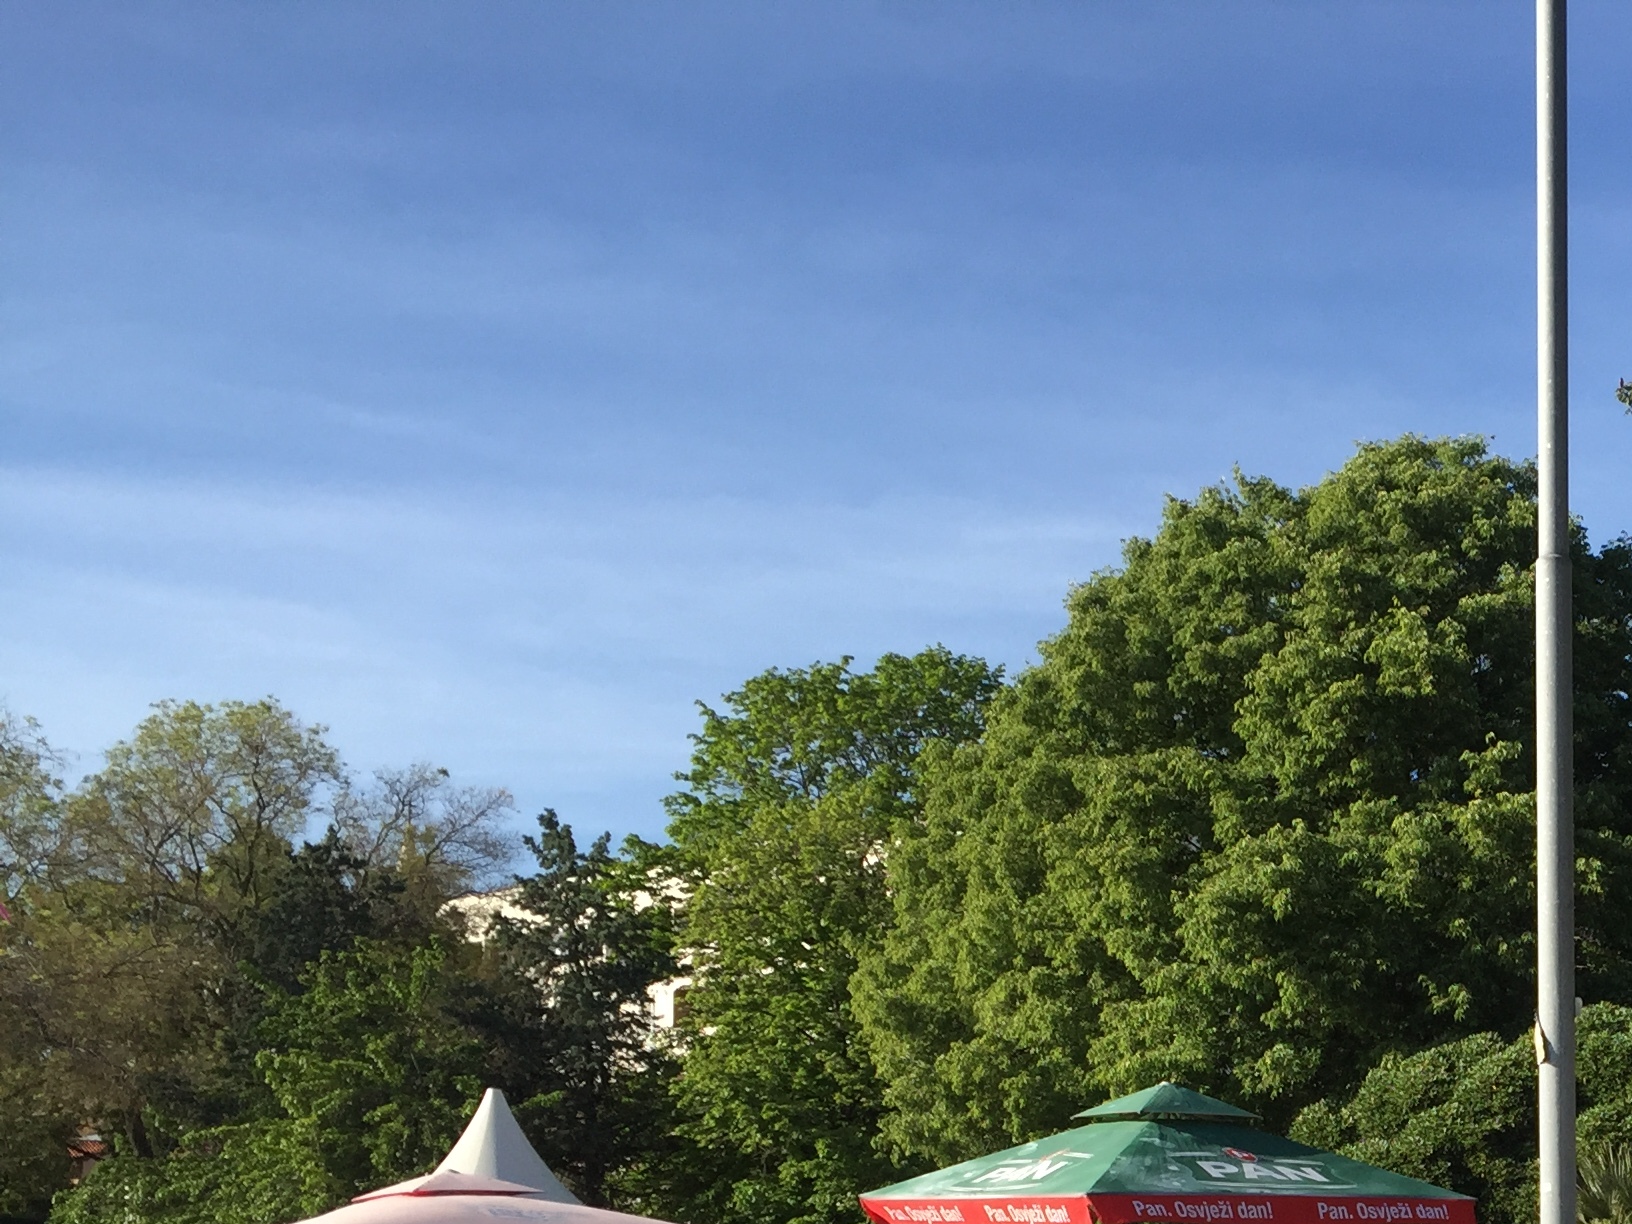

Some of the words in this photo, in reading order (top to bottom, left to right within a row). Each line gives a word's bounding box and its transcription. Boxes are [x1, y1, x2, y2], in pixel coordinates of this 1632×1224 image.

[972, 1160, 1069, 1183] PAN
[1197, 1160, 1331, 1182] PAN
[939, 1206, 965, 1222] dan!
[983, 1205, 1010, 1223] Pan.
[1047, 1205, 1072, 1224] dan!
[1132, 1200, 1173, 1217] Pan.
[1174, 1201, 1234, 1222] Osvježi
[1237, 1201, 1274, 1219] dan!
[1317, 1202, 1354, 1220] Pan.
[1356, 1202, 1413, 1222] Osvježi
[1415, 1203, 1450, 1220] dan!
